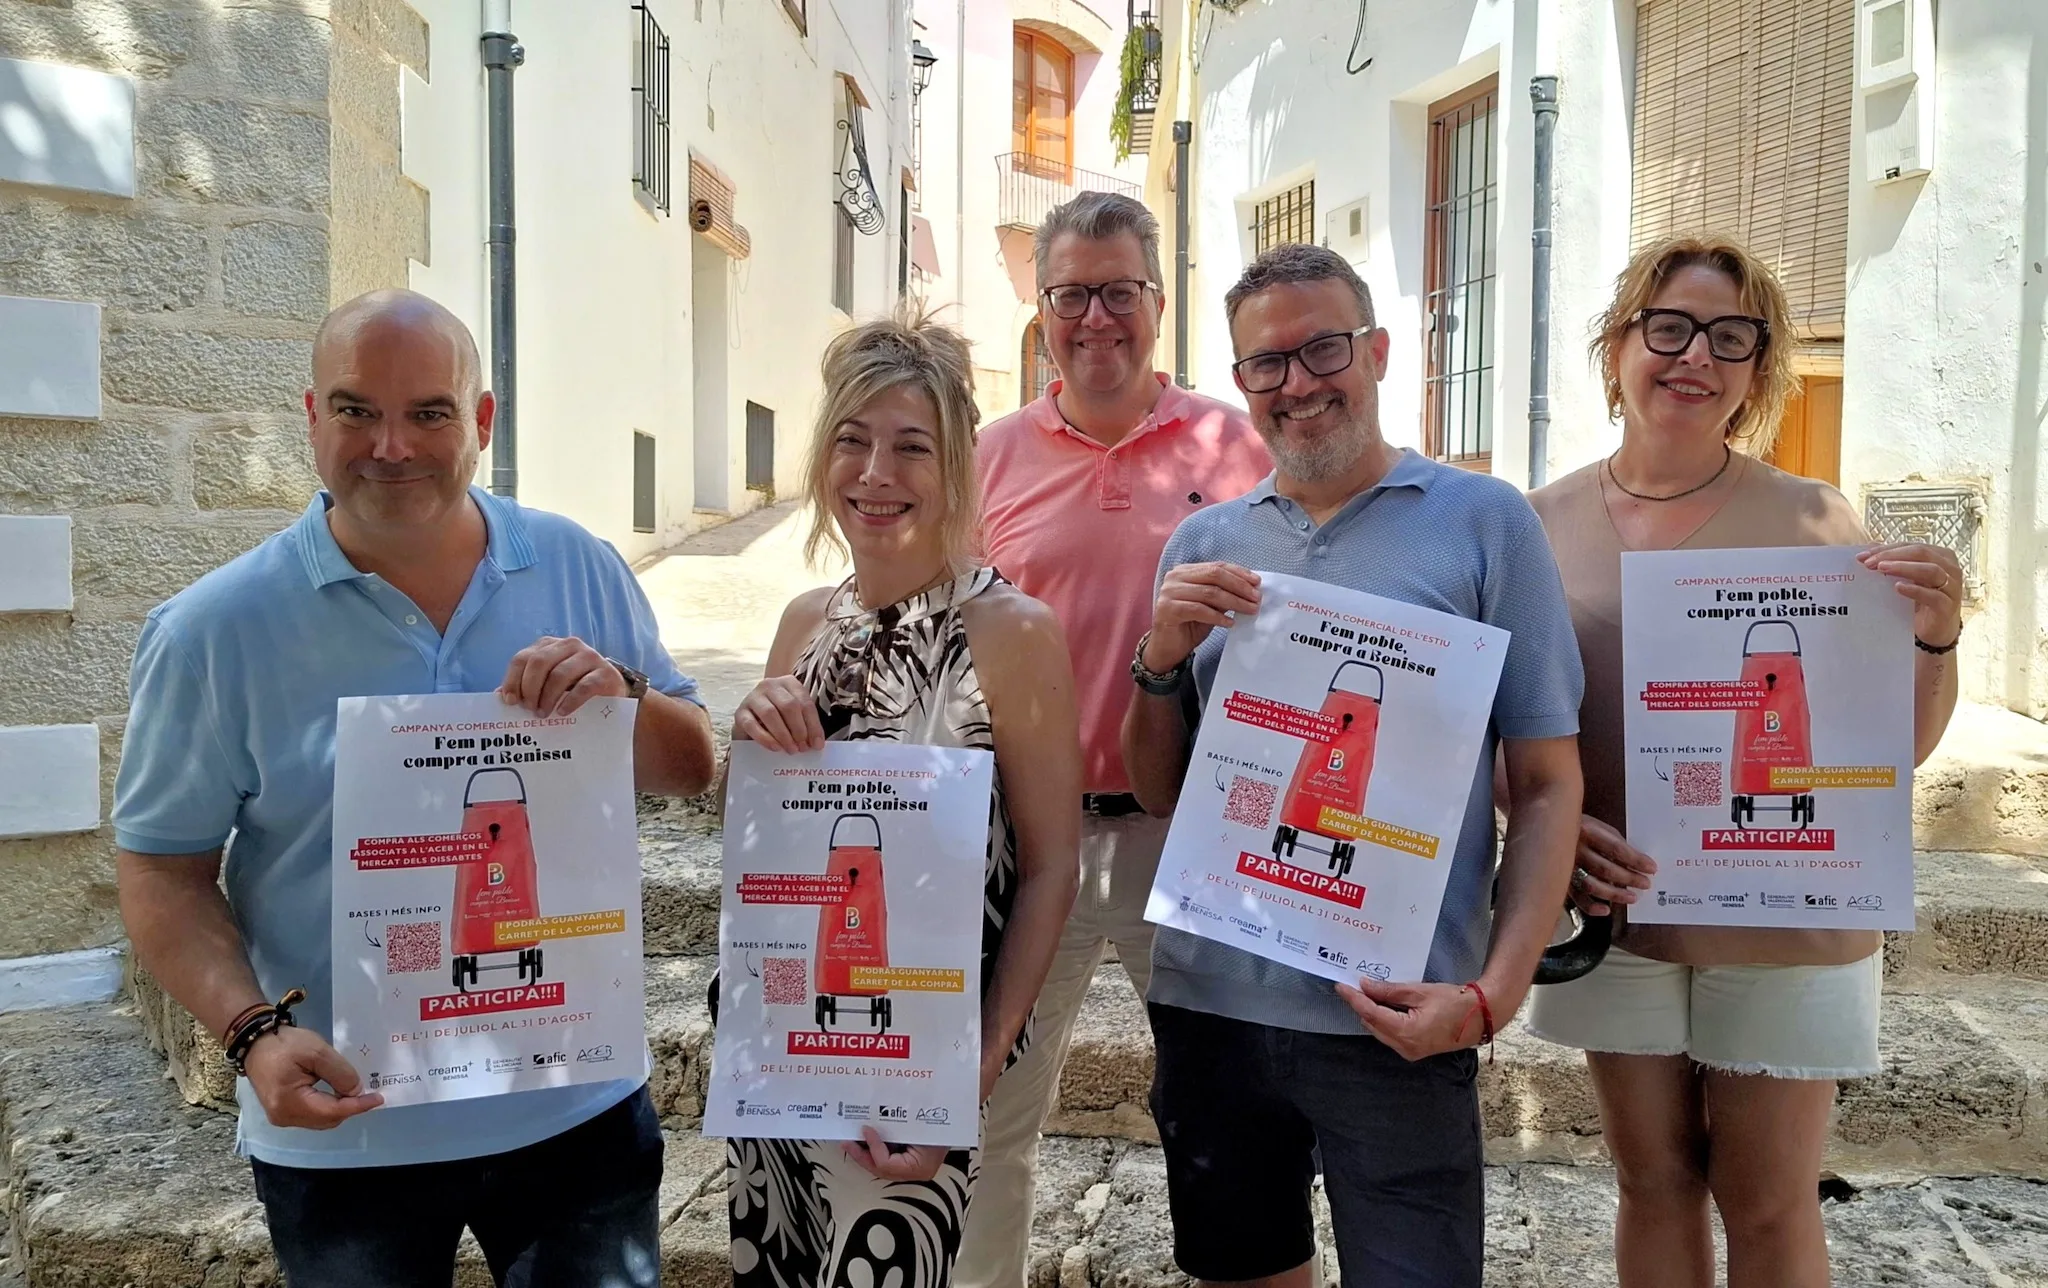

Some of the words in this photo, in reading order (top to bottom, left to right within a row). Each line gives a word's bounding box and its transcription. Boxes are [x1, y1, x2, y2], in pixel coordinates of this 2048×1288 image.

[1675, 578, 1732, 586] CAMPANYA
[1736, 576, 1795, 584] COMERCIAL
[1816, 574, 1854, 582] L'ESTIU
[1716, 589, 1753, 602] Fem
[1759, 588, 1812, 604] poble,
[1687, 606, 1756, 620] compra
[1777, 604, 1848, 616] Benissa
[1288, 600, 1341, 619] CAMPANYA
[1343, 614, 1398, 633] COMERCIAL
[1400, 628, 1412, 637] DE
[1414, 632, 1451, 647] L'ESTIU
[1320, 620, 1354, 640] Fem
[1358, 630, 1407, 654] poble,
[1290, 631, 1352, 656] compra
[1370, 650, 1436, 677] Benissa
[1710, 681, 1759, 690] COMERÇOS
[1227, 700, 1271, 716] ASSOCIATS
[1281, 714, 1309, 727] L'ACEB
[1238, 692, 1272, 707] COMPRA
[1274, 701, 1289, 711] ALS
[1291, 706, 1335, 724] COMERÇOS
[391, 723, 454, 733] CAMPANYA
[457, 721, 520, 731] COMERCIAL
[540, 717, 577, 727] L'ESTIU
[1230, 711, 1263, 724] MERCAT
[1265, 720, 1285, 730] DELS
[1287, 725, 1330, 742] DISSABTES
[435, 736, 475, 750] Fem
[481, 733, 538, 751] poble,
[1678, 746, 1696, 754] MÉS
[403, 754, 478, 770] compra
[500, 748, 572, 764] Benissa
[1207, 752, 1234, 764] BASES
[1242, 759, 1259, 771] MÉS
[1261, 766, 1283, 777] INFO
[827, 769, 882, 777] COMERCIAL
[808, 781, 842, 794] Fem
[846, 782, 896, 796] poble,
[782, 798, 843, 812] compra
[862, 798, 928, 811] Benissa
[364, 837, 404, 846] COMPRA
[428, 832, 482, 842] COMERÇOS
[1321, 818, 1358, 833] CARRET
[1391, 836, 1433, 854] COMPRA.
[1371, 819, 1418, 838] GUANYAR
[1420, 833, 1435, 844] UN
[1709, 831, 1828, 844] PARTICIPA!!!
[354, 848, 407, 856] ASSOCIATS
[420, 845, 454, 854] L'ACEB
[361, 858, 401, 867] MERCAT
[404, 856, 427, 864] DELS
[430, 854, 482, 863] DISSABTES
[1676, 859, 1691, 867] DE
[1695, 859, 1709, 867] L'1
[1714, 859, 1729, 867] DE
[1732, 859, 1770, 869] JULIOL
[1776, 860, 1790, 868] AL
[1794, 860, 1804, 868] 31
[1810, 860, 1862, 869] D'AGOST
[799, 874, 843, 883] COMERÇOS
[1244, 856, 1359, 900] PARTICIPA!!!
[1207, 874, 1221, 883] DE
[1225, 878, 1239, 888] L'1
[1243, 883, 1257, 895] DE
[1258, 888, 1296, 908] JULIOL
[1300, 903, 1314, 912] AL
[1317, 908, 1329, 919] 31
[1332, 913, 1383, 934] D'AGOST
[1818, 895, 1837, 906] afic
[349, 909, 381, 918] BASES
[391, 906, 412, 916] MÉS
[416, 906, 441, 914] INFO
[552, 913, 602, 925] GUANYAR
[1189, 905, 1223, 922] BENISSA
[498, 930, 539, 940] CARRET
[576, 922, 622, 932] COMPRA.
[767, 941, 783, 949] MÉS
[1330, 947, 1348, 966] afic
[898, 968, 943, 976] GUANYAR
[854, 978, 888, 986] CARRET
[920, 980, 961, 988] COMPRA.
[428, 986, 558, 1012] PARTICIPA!!!
[392, 1033, 408, 1042] DE
[412, 1031, 429, 1040] L'1
[434, 1028, 450, 1038] DE
[454, 1022, 497, 1036] JULIOL
[501, 1020, 518, 1030] AL
[522, 1018, 533, 1028] 31
[539, 1012, 592, 1026] D'AGOST
[794, 1035, 903, 1050] PARTICIPA!!!
[547, 1052, 566, 1064] afic
[798, 1065, 812, 1073] DE
[815, 1065, 850, 1075] JULIOL
[854, 1067, 868, 1075] AL
[871, 1067, 881, 1076] 31
[886, 1068, 933, 1078] D'AGOST
[382, 1074, 422, 1086] BENISSA
[746, 1108, 781, 1116] BENISSA
[890, 1106, 907, 1118] afic
